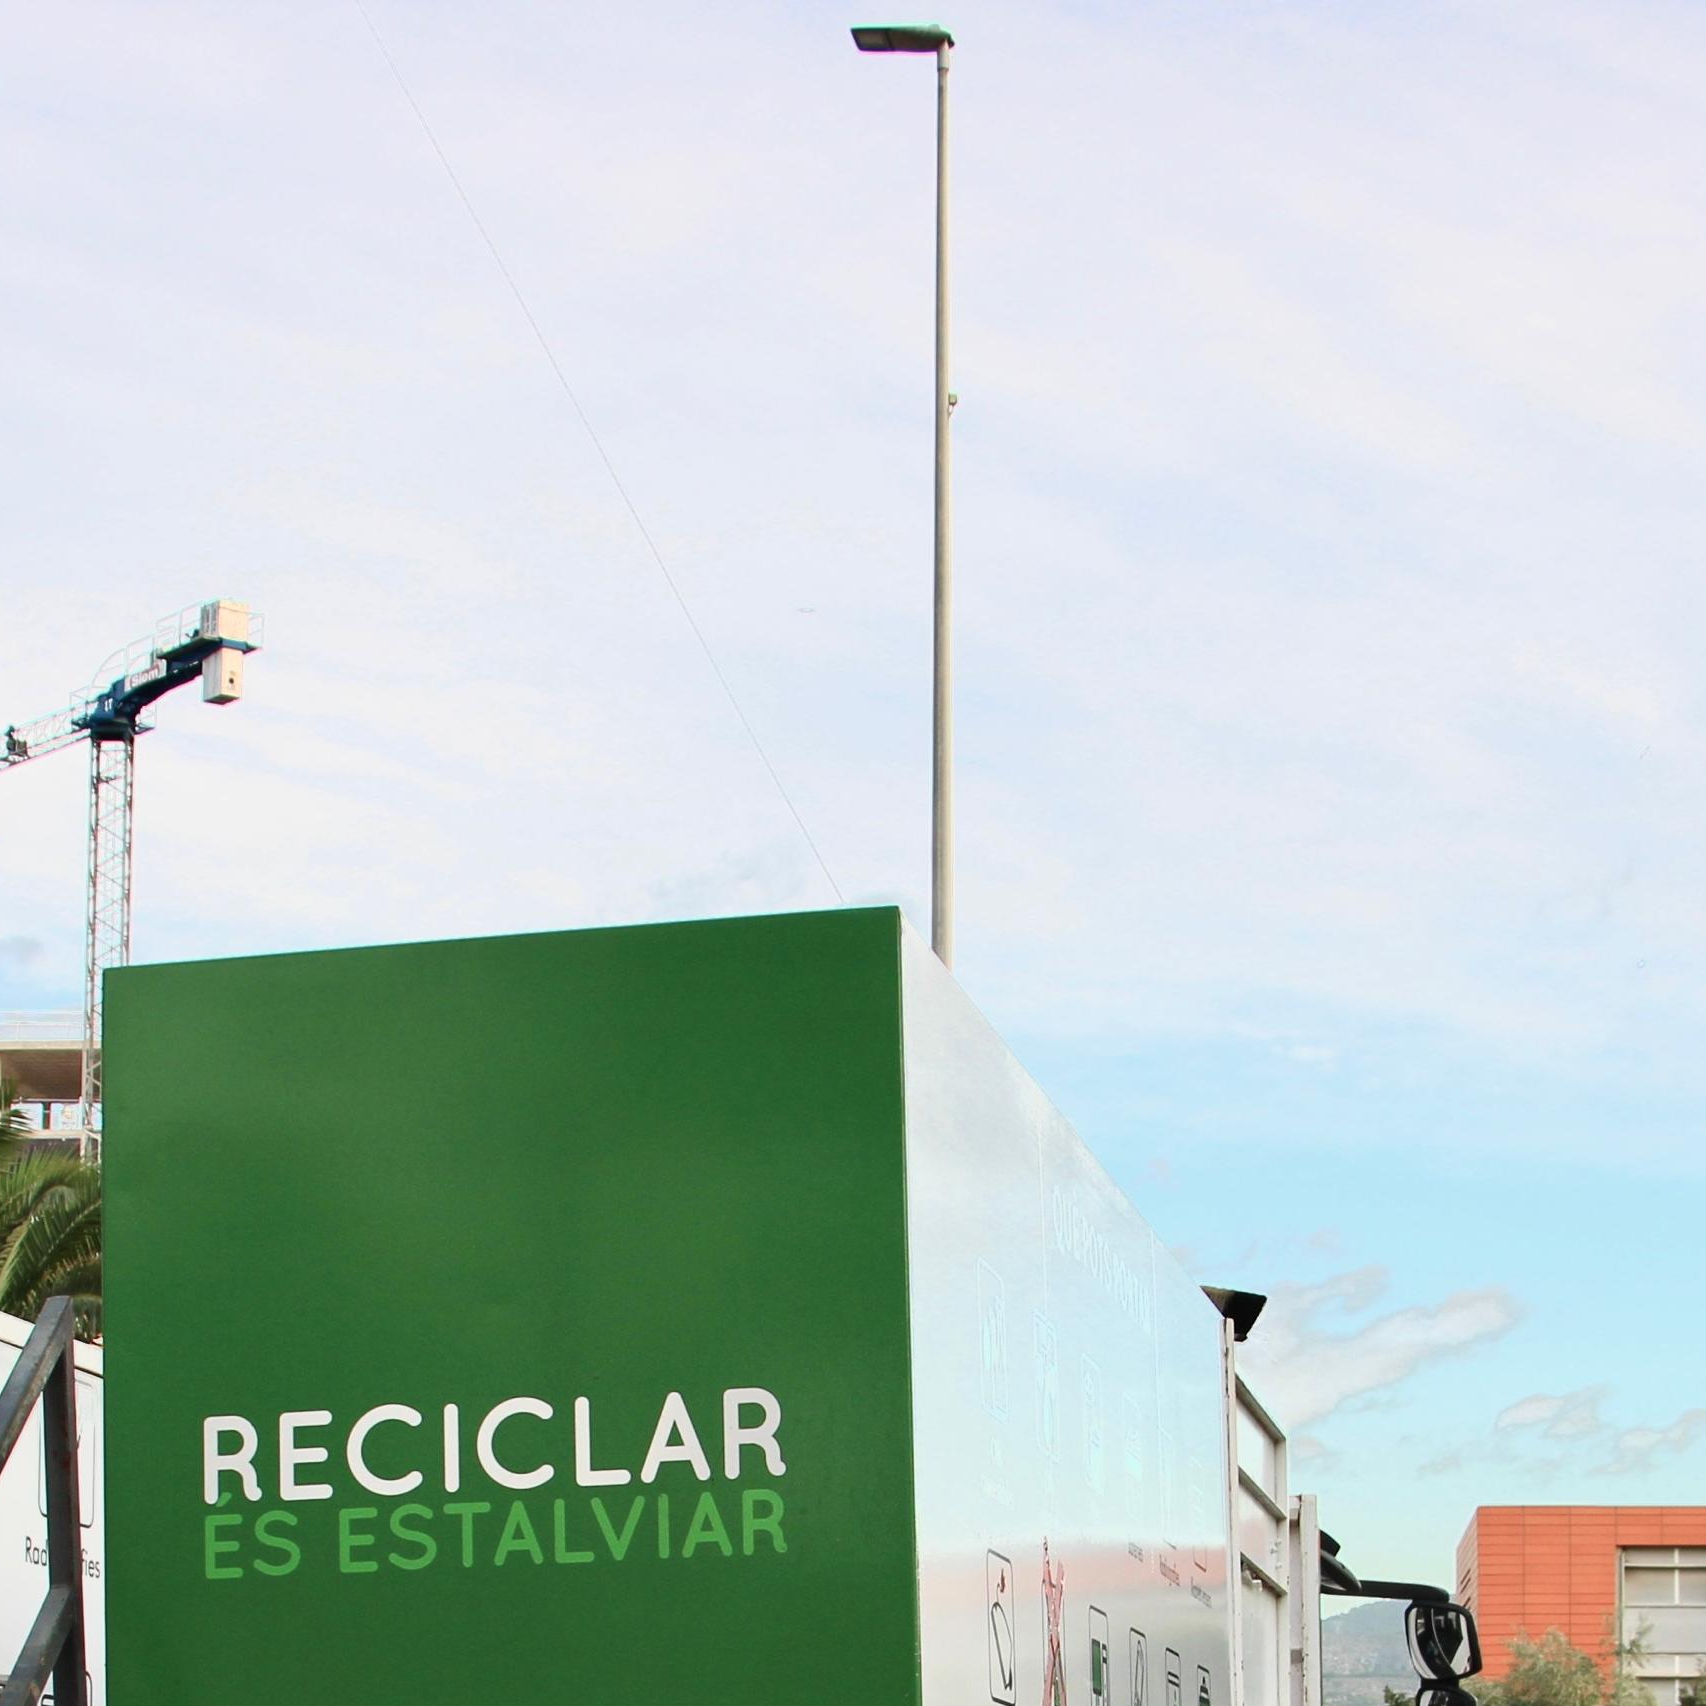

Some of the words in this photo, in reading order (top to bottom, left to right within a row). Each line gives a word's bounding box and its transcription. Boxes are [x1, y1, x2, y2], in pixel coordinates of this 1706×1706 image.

[203, 1387, 786, 1504] RECICLAR
[204, 1492, 301, 1579] ÉS
[339, 1489, 787, 1573] ESTALVIAR
